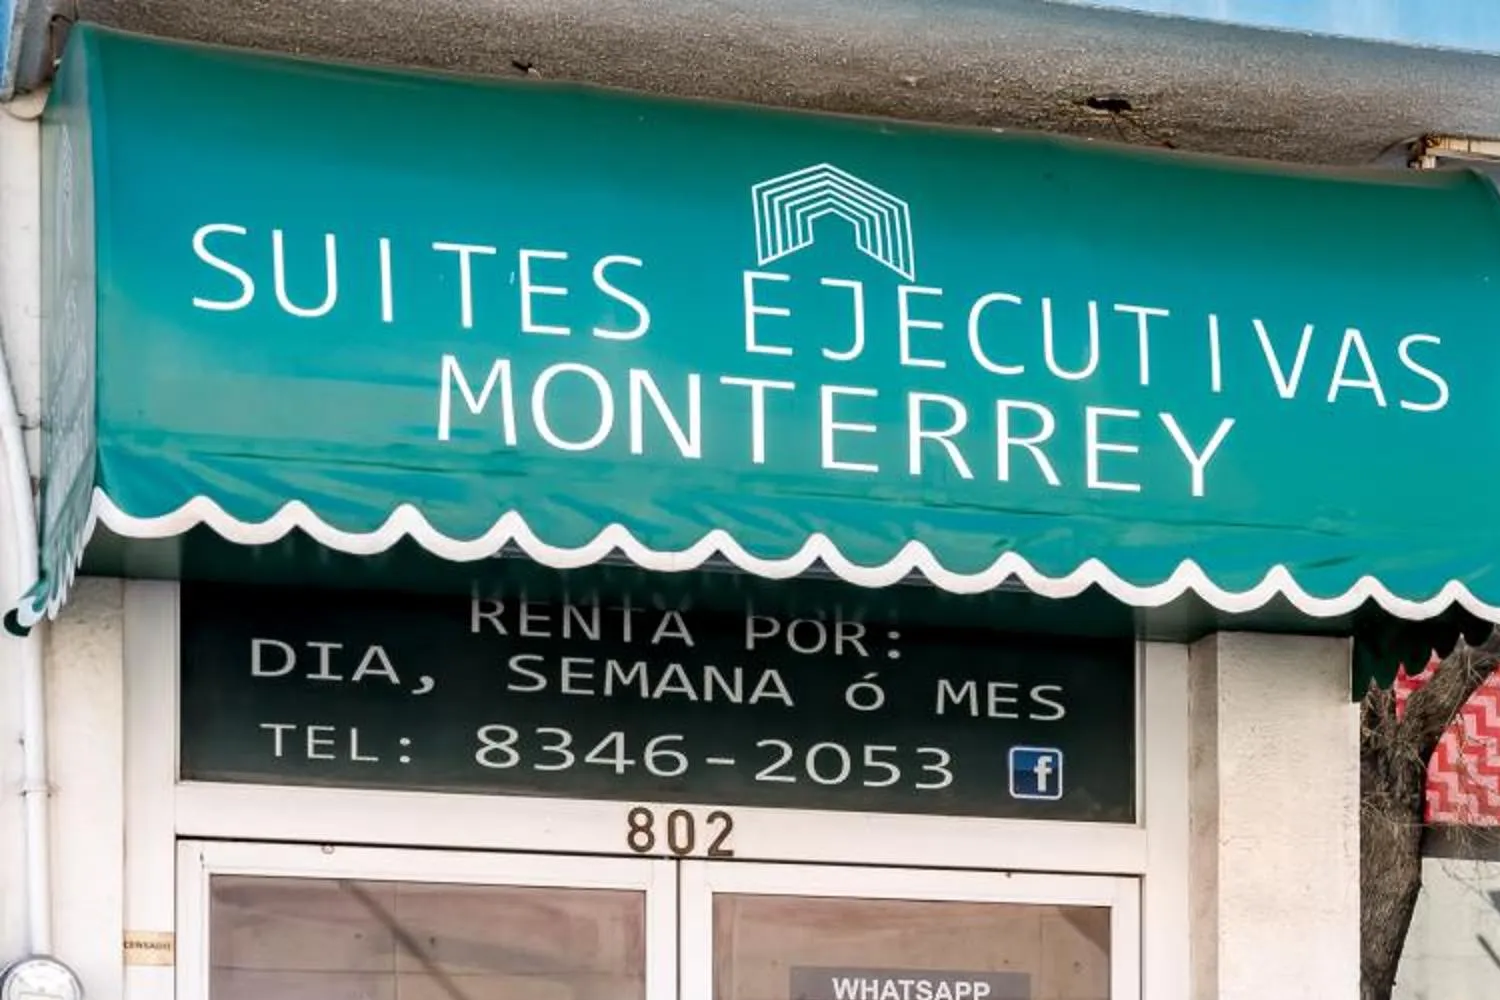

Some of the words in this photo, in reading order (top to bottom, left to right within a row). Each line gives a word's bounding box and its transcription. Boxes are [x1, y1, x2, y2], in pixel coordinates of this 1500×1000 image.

[192, 222, 650, 341] SUITES
[743, 271, 1449, 412] EJECUTIVAS
[438, 354, 1234, 497] MONTERREY
[470, 598, 694, 646] RENTA
[746, 615, 900, 659] POR:
[251, 638, 435, 695] DIA,
[507, 650, 794, 707] SEMANA
[936, 679, 1066, 721] MES
[260, 723, 412, 764] TEL:
[474, 723, 954, 790] 8346-2053
[627, 806, 736, 858] 802
